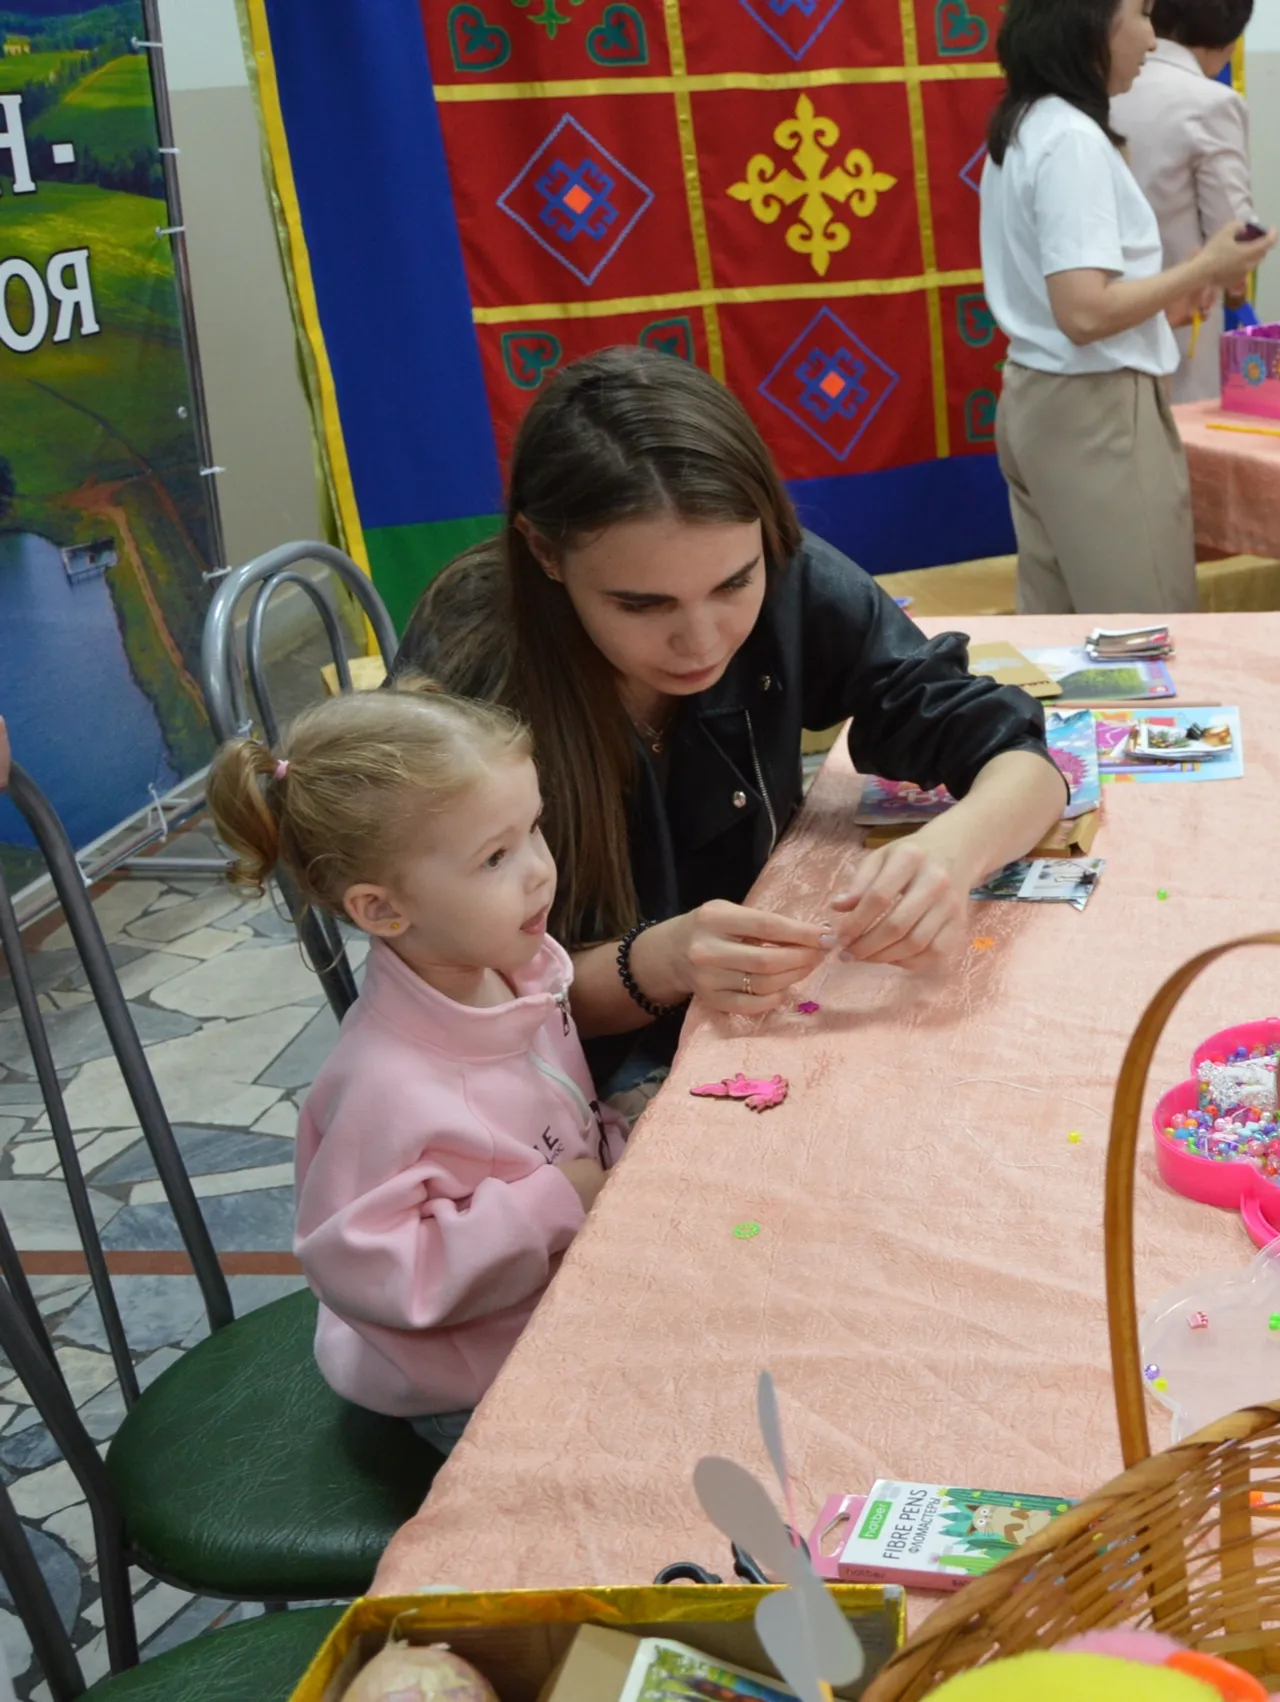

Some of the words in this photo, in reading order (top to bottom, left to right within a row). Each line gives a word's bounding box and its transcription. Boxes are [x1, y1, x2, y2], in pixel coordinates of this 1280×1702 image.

[862, 1503, 888, 1538] hatber
[882, 1524, 913, 1559] FIBRE
[899, 1490, 928, 1521] PENS
[908, 1497, 941, 1553] ФЛОМАСТЕРЫ
